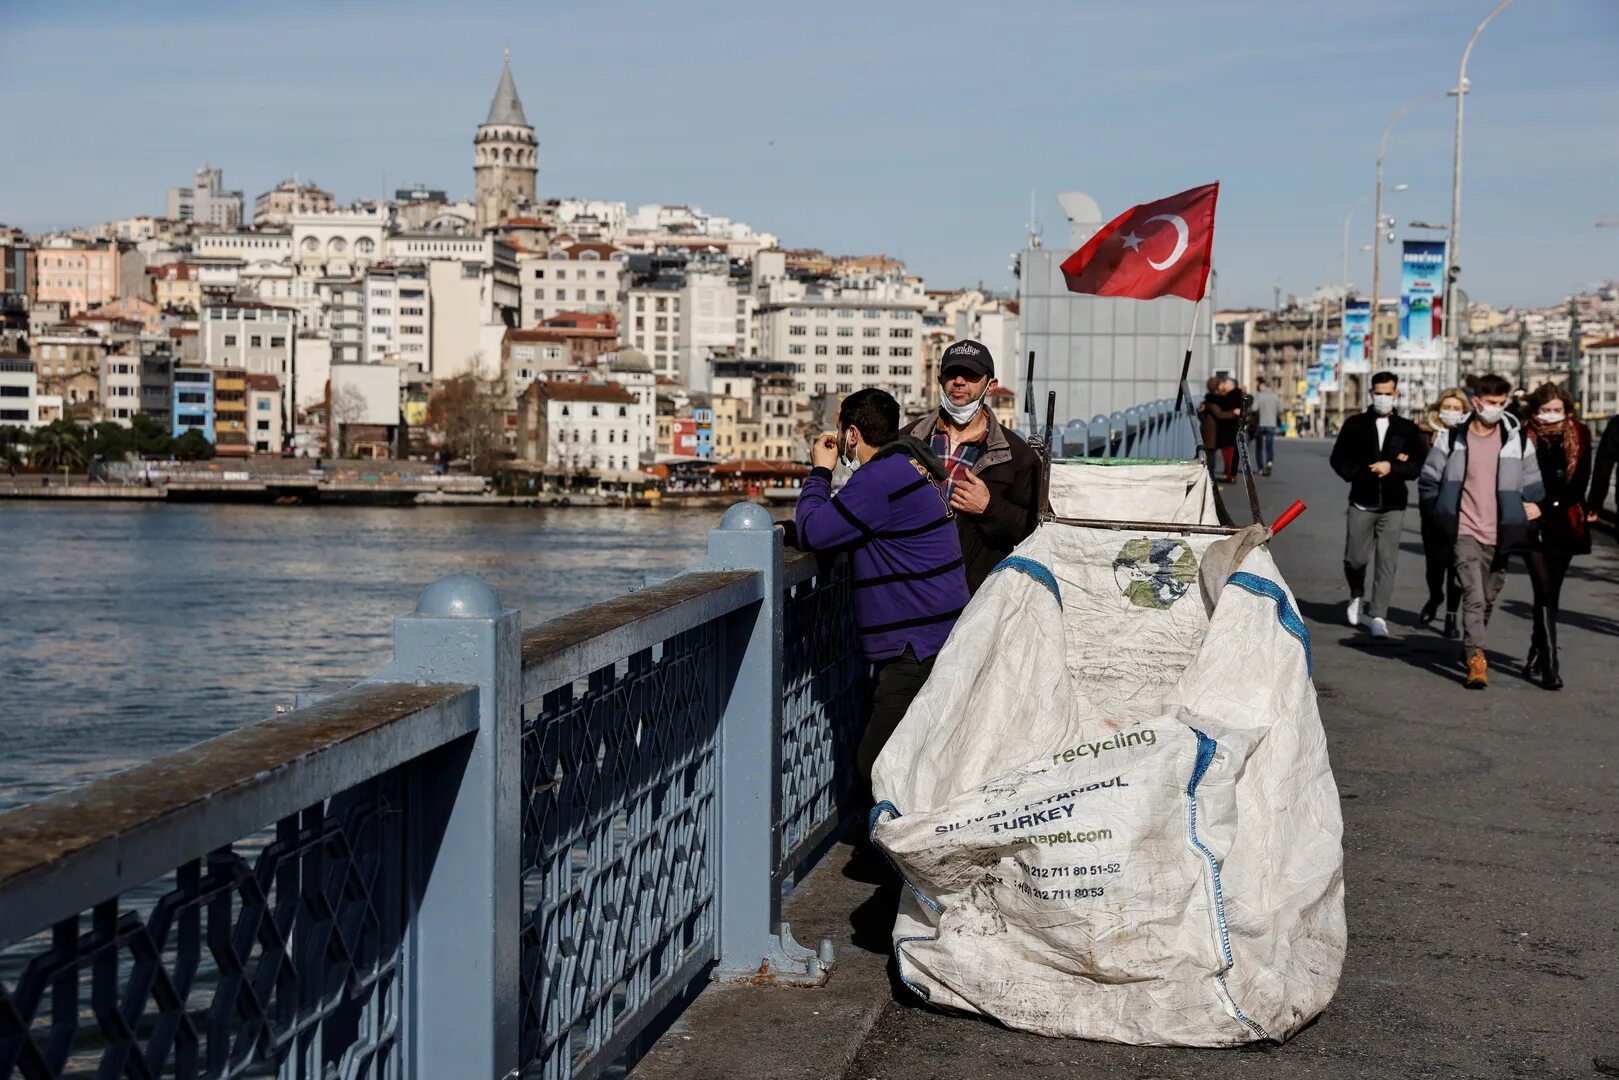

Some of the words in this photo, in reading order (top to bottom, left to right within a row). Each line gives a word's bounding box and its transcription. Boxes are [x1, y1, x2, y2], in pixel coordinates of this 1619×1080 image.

[1052, 729, 1157, 766] recycling
[988, 803, 1076, 833] TURKEY
[1031, 865, 1048, 878] 212
[1051, 866, 1069, 877] 711
[1073, 866, 1087, 875] 80
[1090, 863, 1121, 876] 51-52
[1033, 888, 1050, 900] 212
[1052, 889, 1070, 900] 711
[1074, 888, 1088, 898] 80
[1090, 887, 1104, 897] 53
